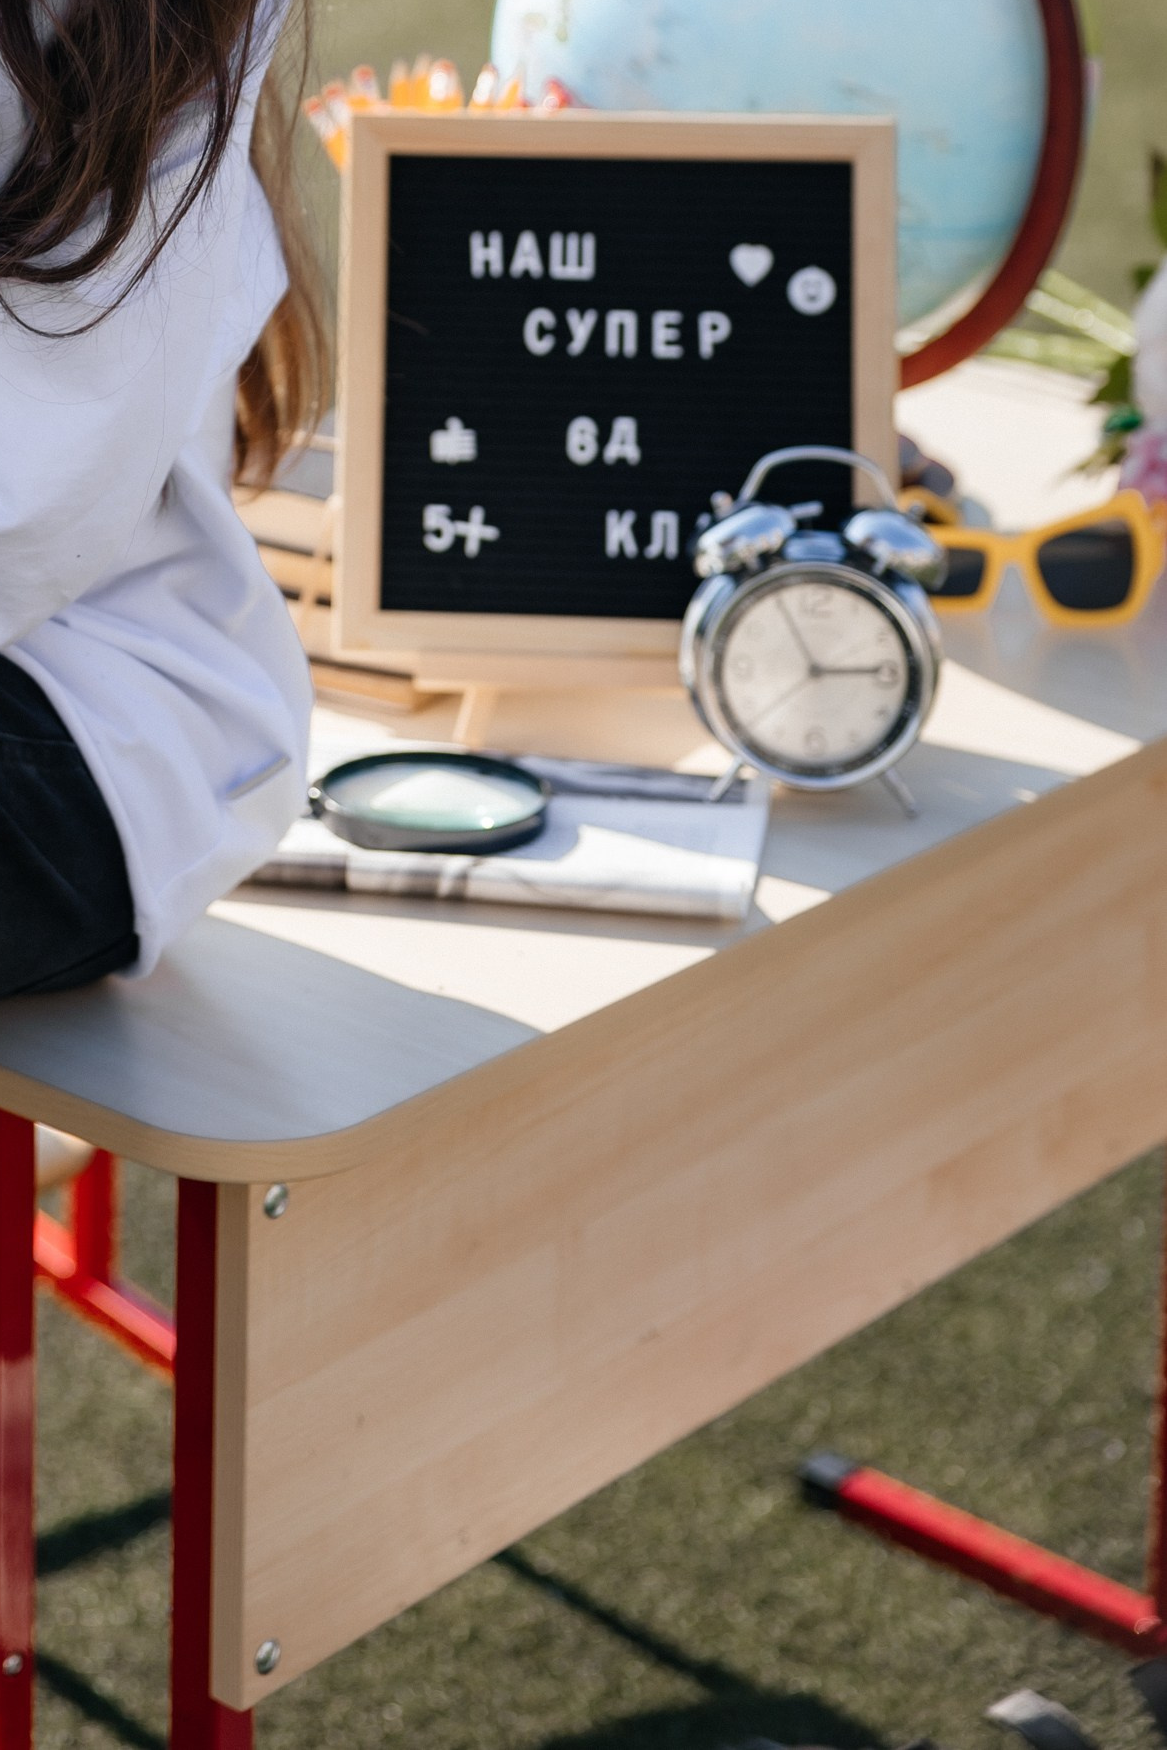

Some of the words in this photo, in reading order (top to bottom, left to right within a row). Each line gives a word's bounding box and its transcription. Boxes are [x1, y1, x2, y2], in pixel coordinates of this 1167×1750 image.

[469, 230, 596, 281] НАШ
[522, 307, 732, 360] СУПЕР
[422, 503, 501, 558] 5+
[604, 509, 714, 559] КЛ
